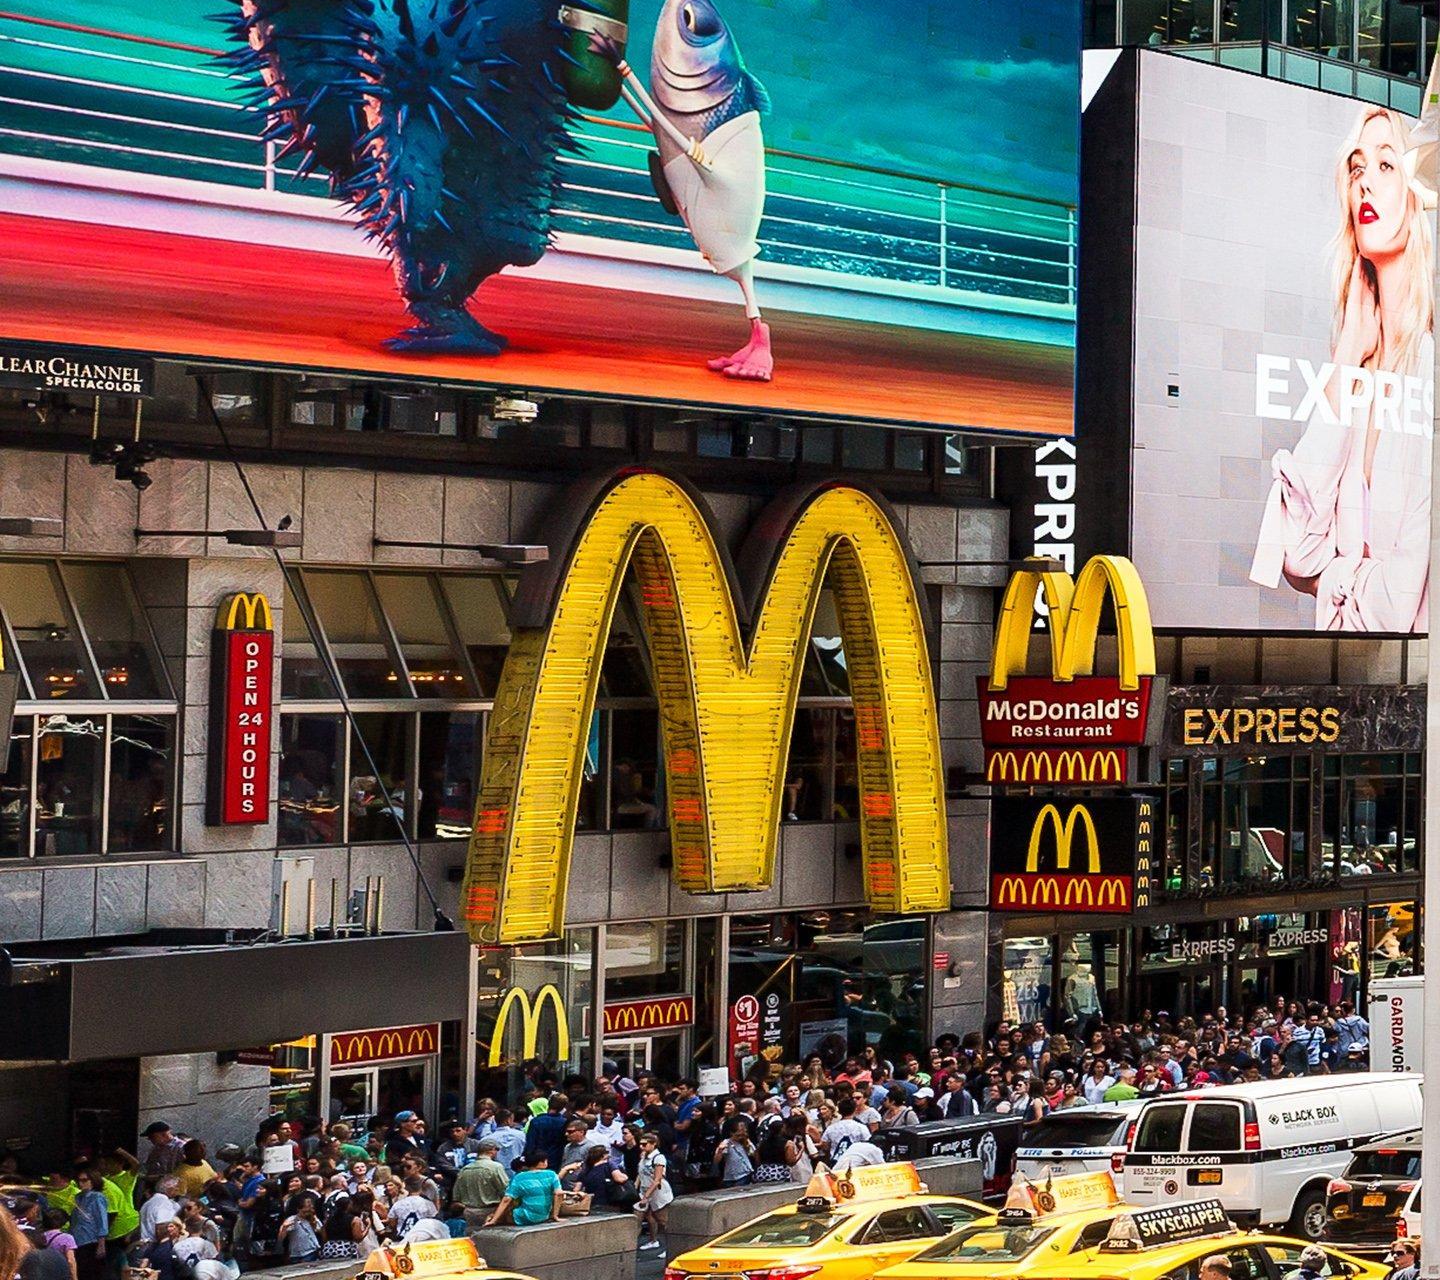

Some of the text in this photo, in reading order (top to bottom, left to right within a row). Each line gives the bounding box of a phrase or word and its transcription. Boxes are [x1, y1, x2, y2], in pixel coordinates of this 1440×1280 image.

[46, 376, 141, 393] SPECTACOLOR
[244, 642, 259, 706] OPEN
[238, 712, 263, 727] 24
[987, 696, 1142, 724] McDonald's
[1011, 723, 1114, 739] Restaurant
[1183, 708, 1341, 746] EXPRESS
[241, 735, 256, 814] HOURS
[1171, 938, 1236, 957] EXPRESS
[1269, 930, 1328, 947] EXPRESS
[1282, 1105, 1337, 1124] BLACK BOX
[1151, 1155, 1221, 1165] blackbox.com
[1281, 1144, 1336, 1159] blackbox.com
[1137, 1201, 1219, 1221] DWAYNE JOHNSON
[1141, 1207, 1225, 1237] SKYSCRAPER
